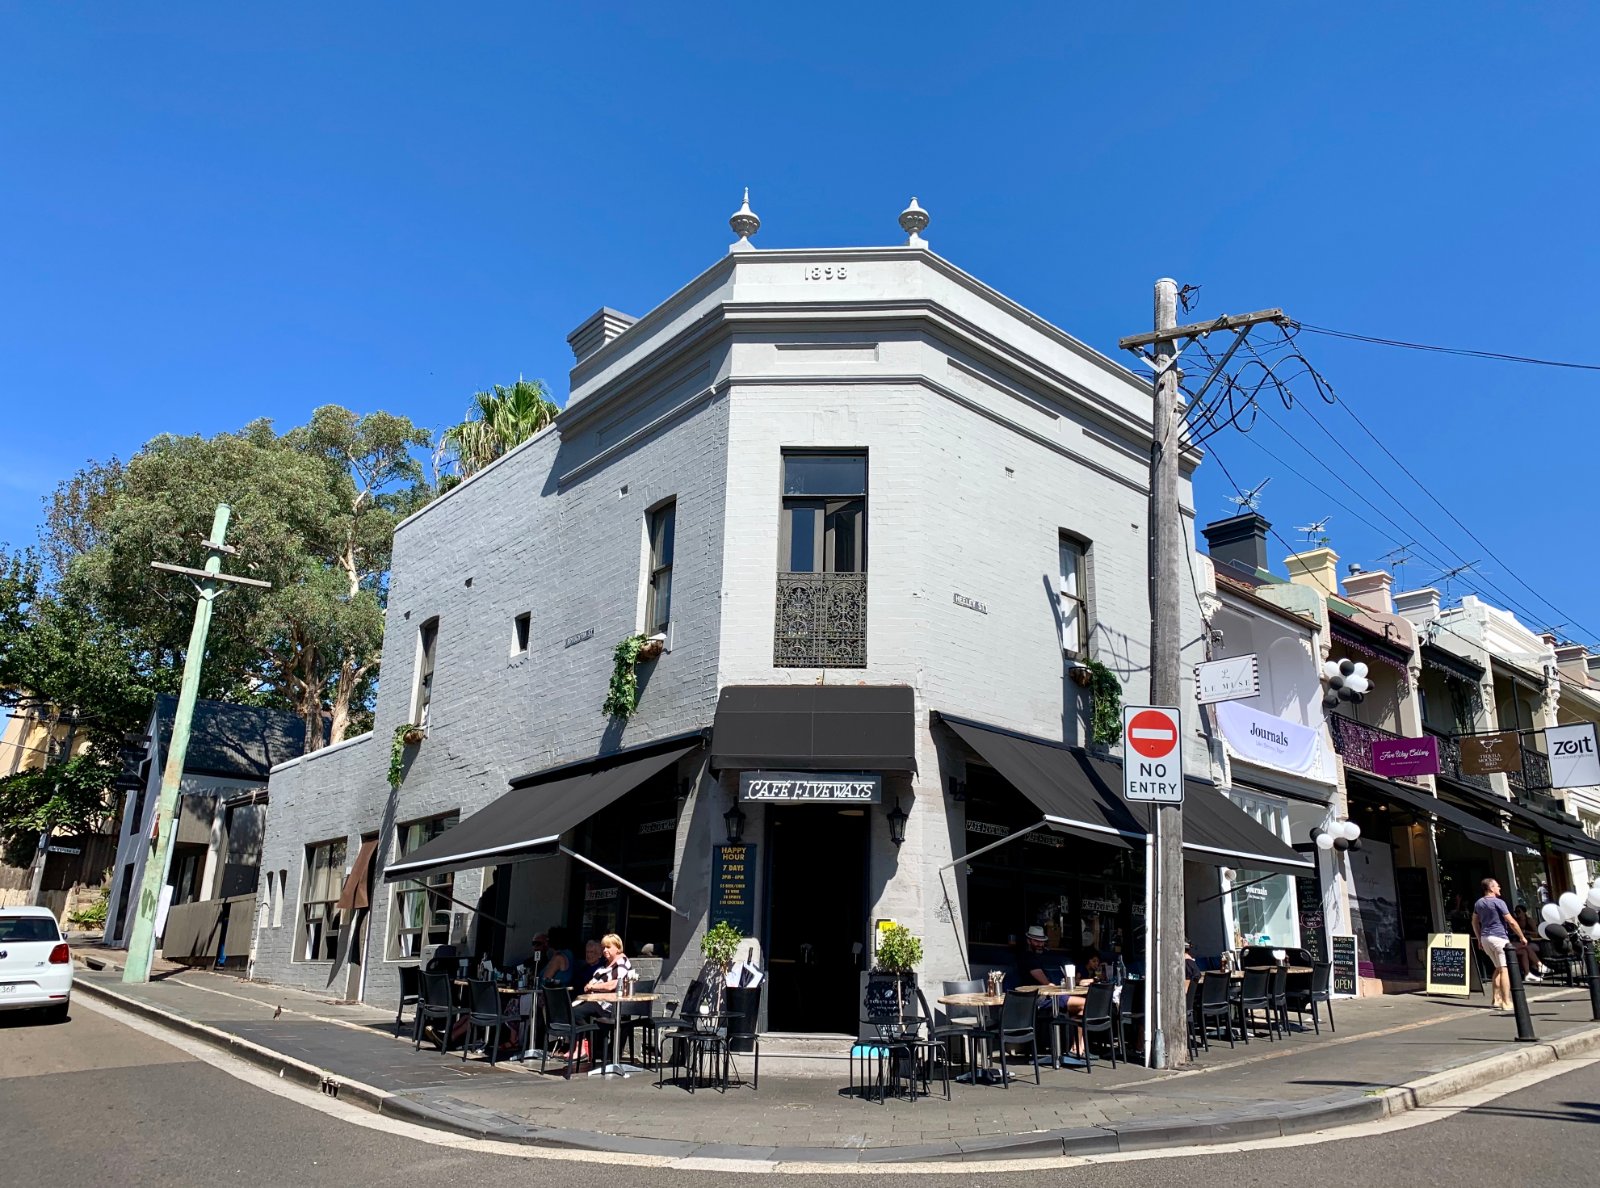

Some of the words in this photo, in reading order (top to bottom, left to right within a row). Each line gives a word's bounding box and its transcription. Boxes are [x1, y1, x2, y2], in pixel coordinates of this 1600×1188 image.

[804, 266, 848, 281] 1898
[1222, 680, 1250, 690] MUSE
[1250, 722, 1289, 747] Journals
[1379, 750, 1395, 761] Five
[1140, 763, 1167, 778] NO
[1130, 781, 1177, 795] ENTRY
[1334, 978, 1353, 990] OPEN
